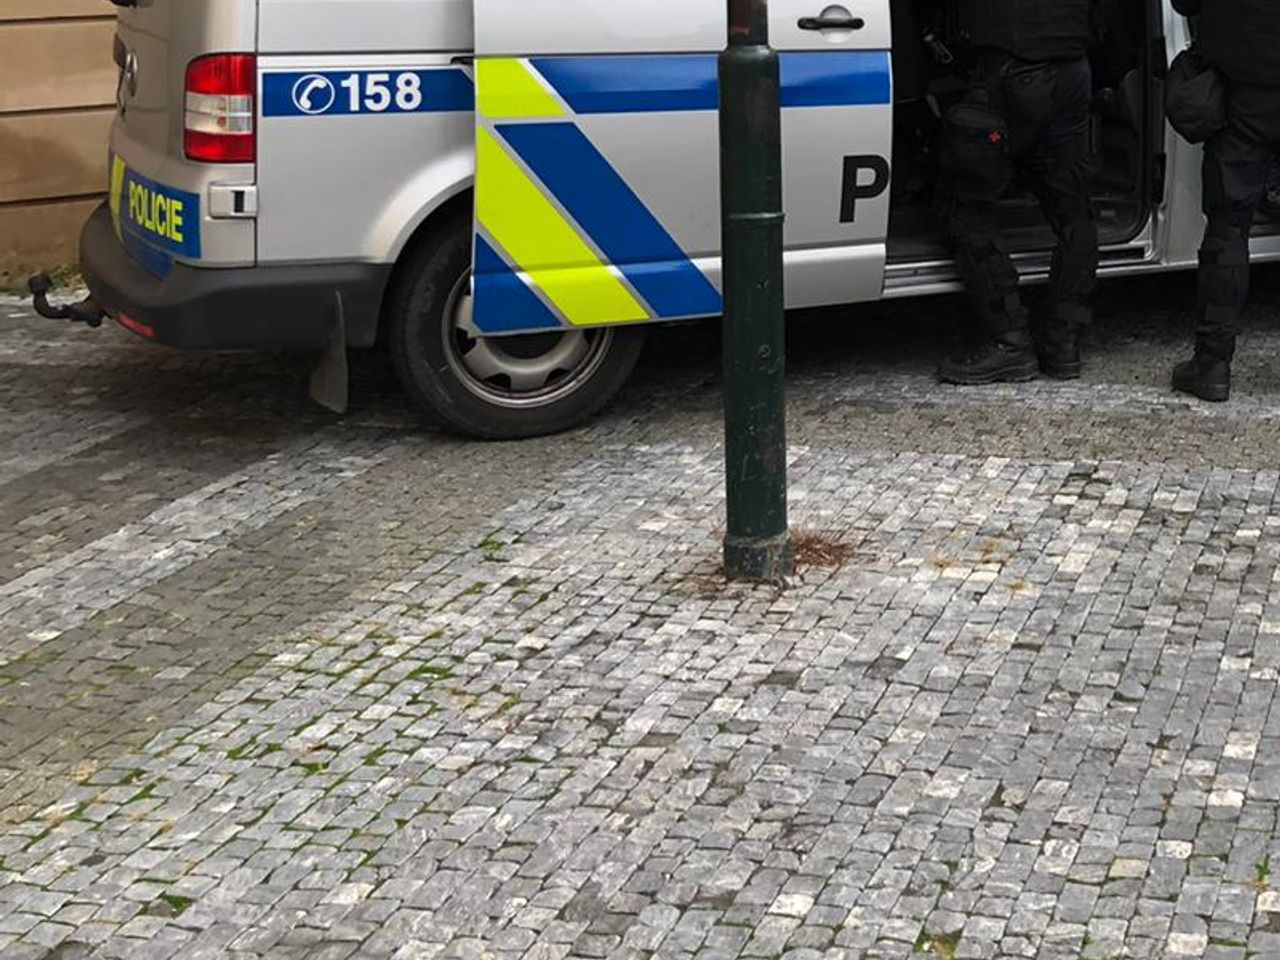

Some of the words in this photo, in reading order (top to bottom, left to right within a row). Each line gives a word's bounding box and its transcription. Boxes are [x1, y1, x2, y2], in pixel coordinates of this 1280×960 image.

[341, 72, 422, 111] 158
[129, 181, 184, 243] POLICIE
[839, 154, 889, 223] P
